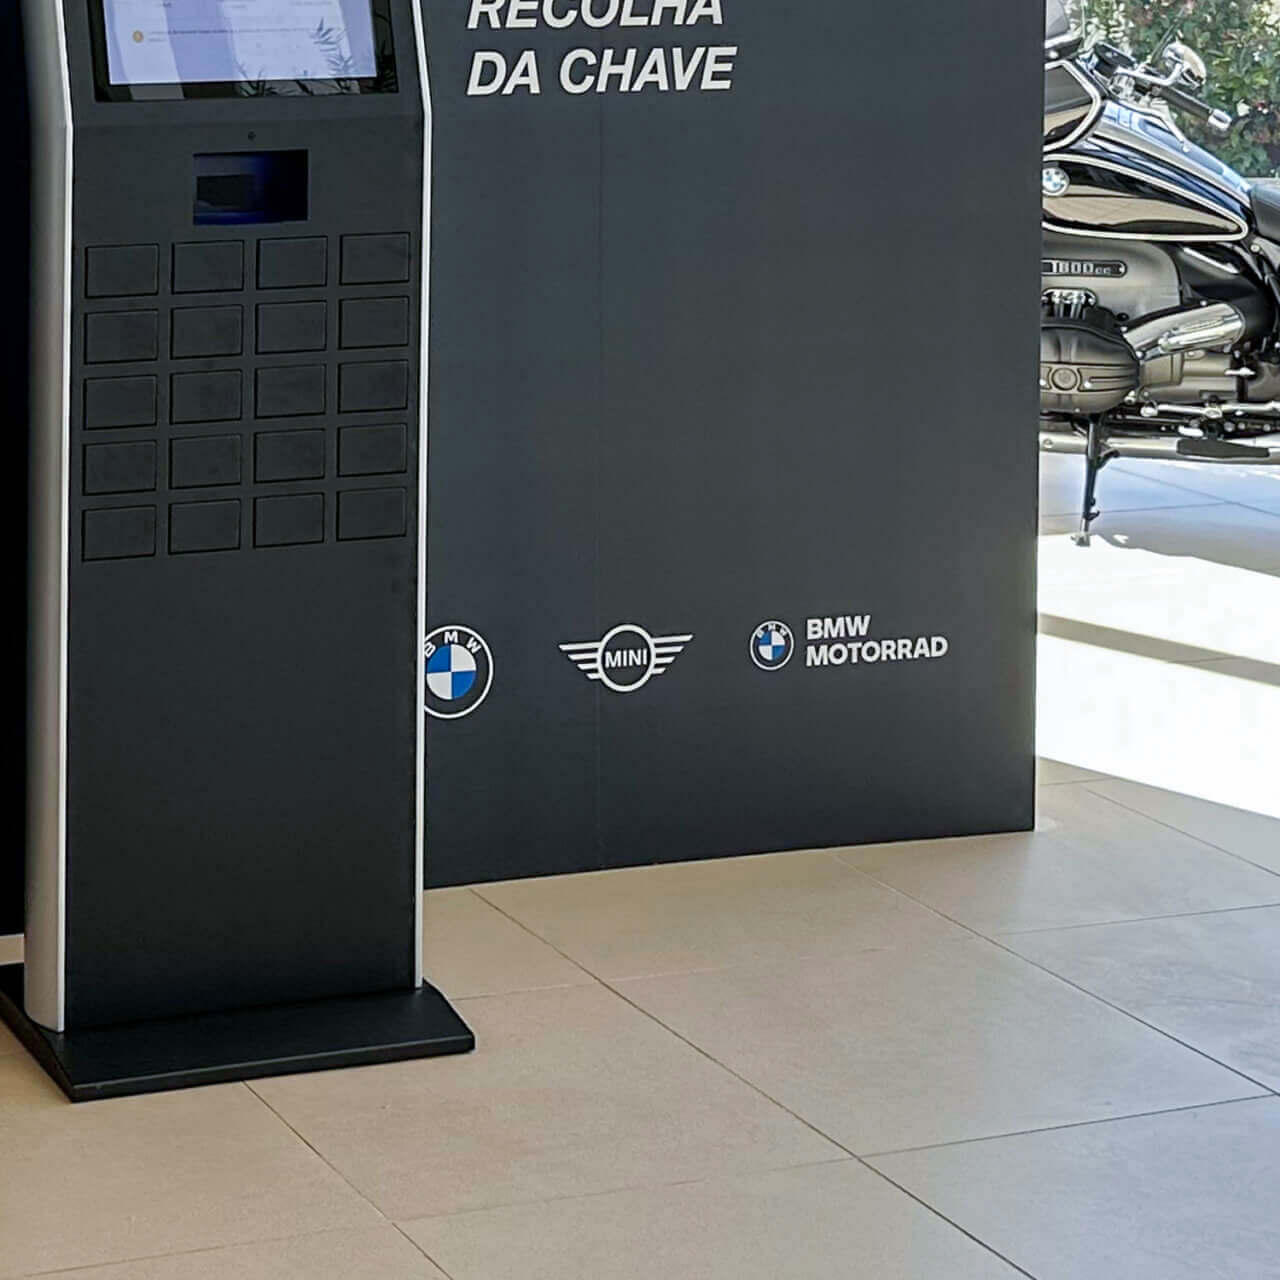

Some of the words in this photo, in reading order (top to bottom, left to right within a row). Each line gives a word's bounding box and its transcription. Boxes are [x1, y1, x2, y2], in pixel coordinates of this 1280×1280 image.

[467, 50, 540, 96] DA
[559, 46, 738, 94] CHAVE
[756, 623, 788, 638] BMW
[806, 615, 872, 640] BMW
[604, 648, 648, 669] MINI
[806, 635, 949, 667] MOTORRAD
